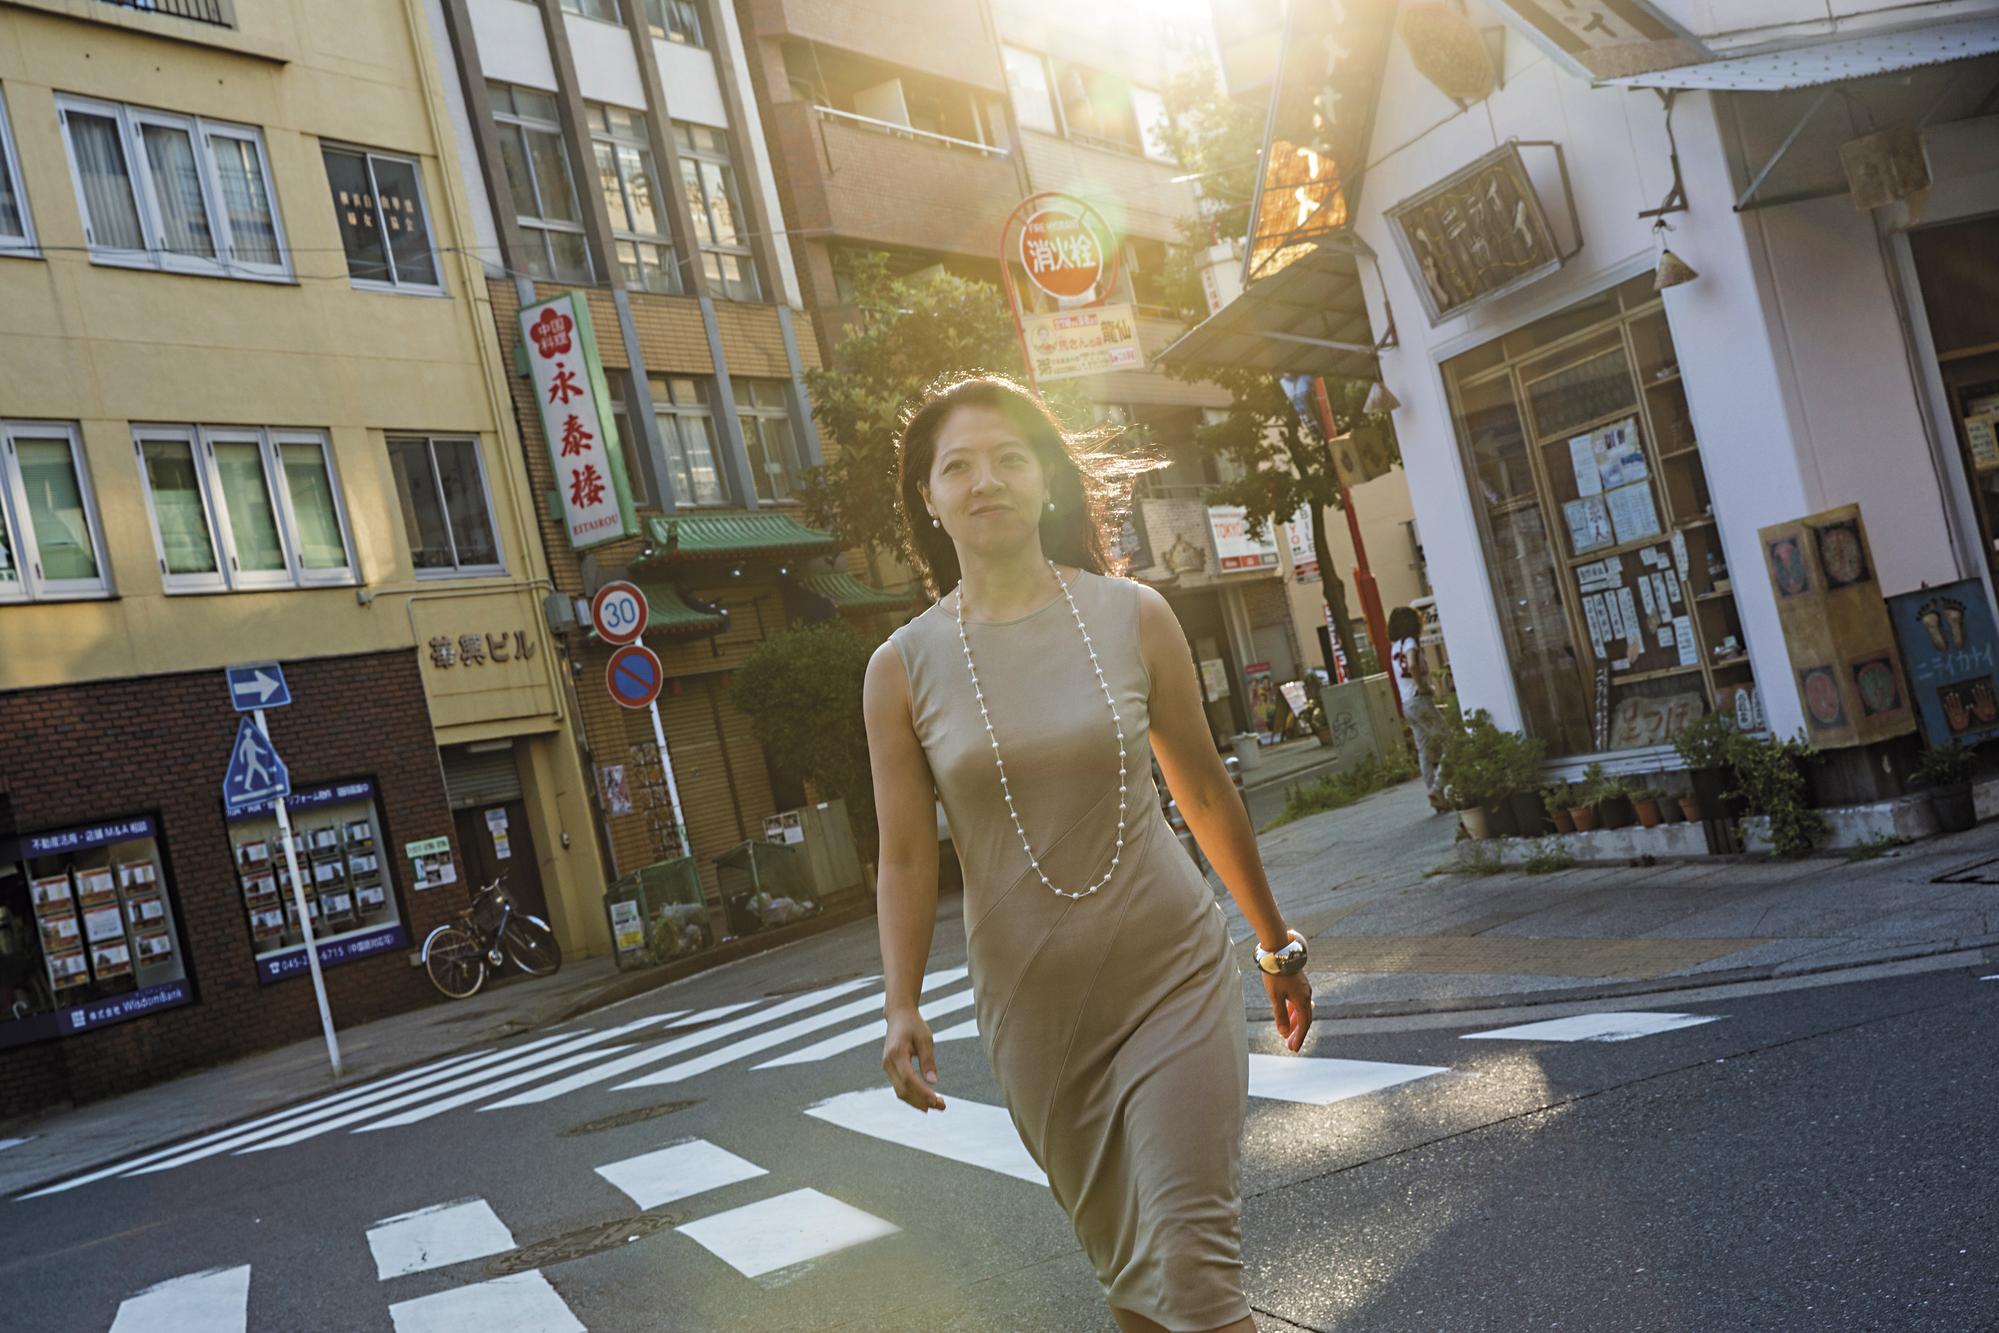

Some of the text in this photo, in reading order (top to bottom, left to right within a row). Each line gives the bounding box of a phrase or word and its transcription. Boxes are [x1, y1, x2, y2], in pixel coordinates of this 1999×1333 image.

[1026, 234, 1097, 273] 消火栓
[538, 317, 565, 337] 中国
[539, 331, 569, 350] 料理
[1101, 319, 1132, 345] 龍仙
[548, 362, 606, 509] 永泰楼
[572, 513, 619, 537] EITAIROU
[604, 597, 636, 629] 30
[429, 630, 536, 670] 華興ビル
